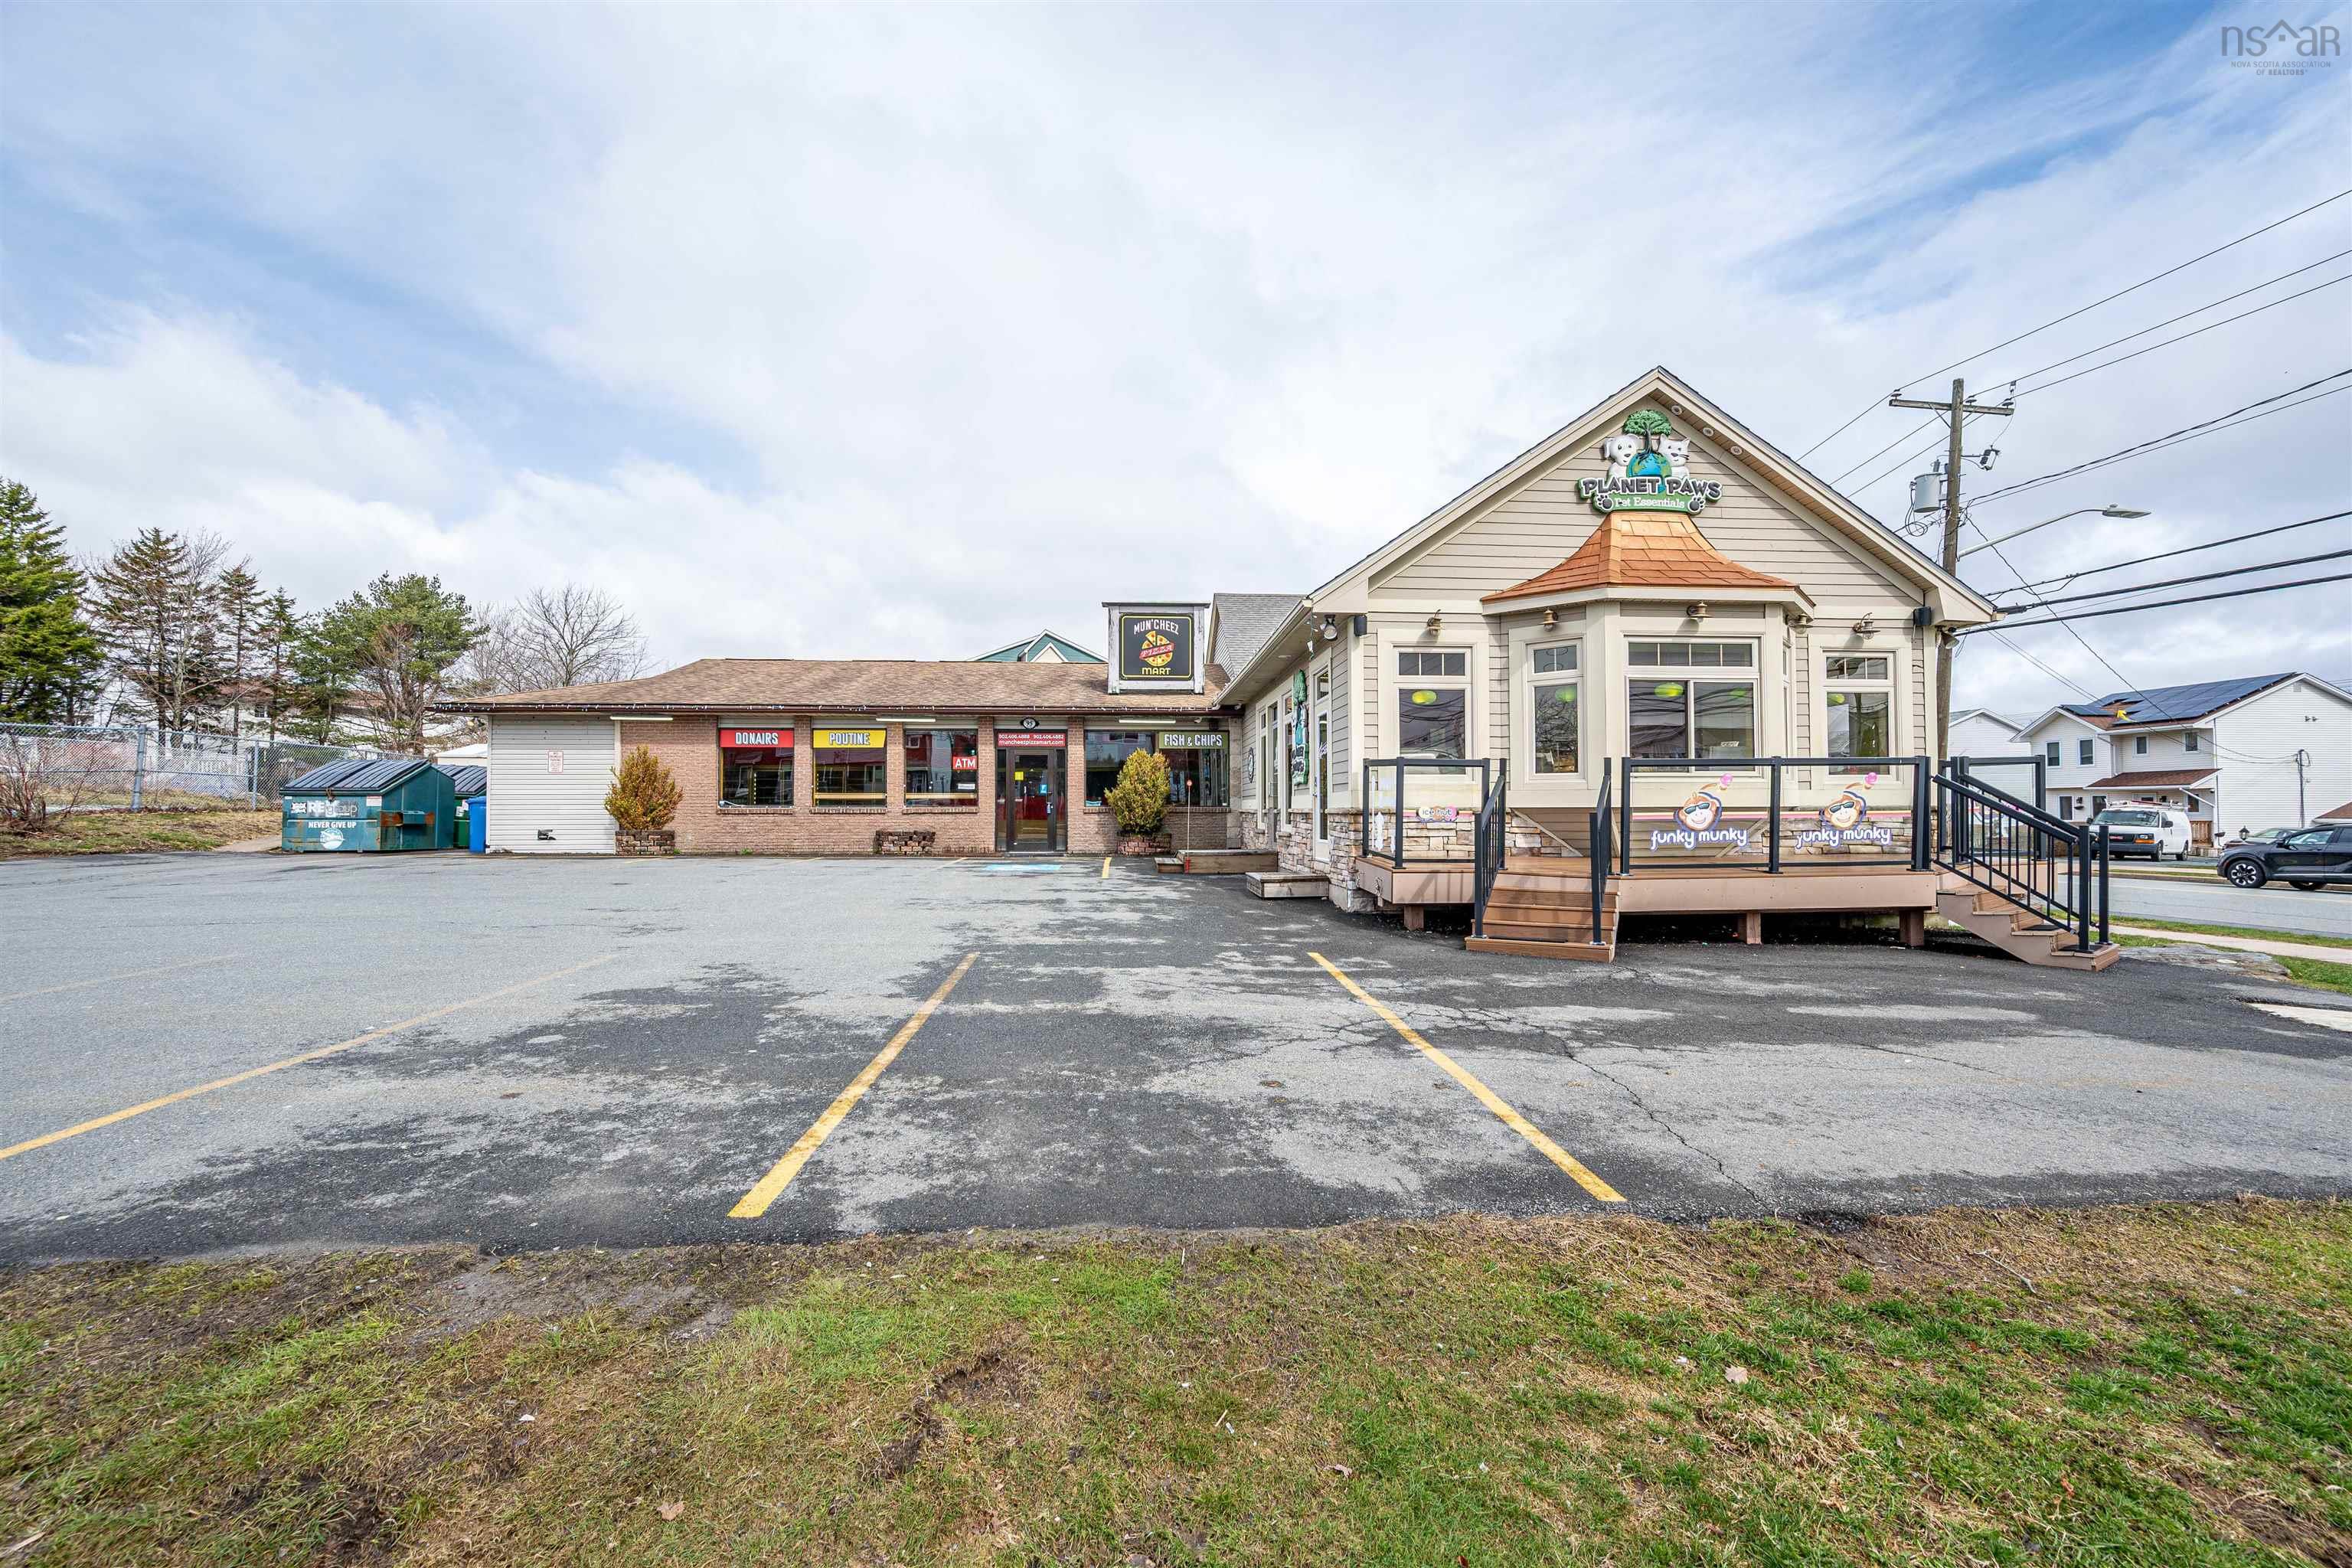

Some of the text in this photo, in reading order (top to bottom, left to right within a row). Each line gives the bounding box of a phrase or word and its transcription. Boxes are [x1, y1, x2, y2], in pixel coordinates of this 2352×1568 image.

[1582, 477, 1722, 498] PLANET PAWS
[1614, 497, 1685, 508] Pet Essentials
[1133, 619, 1179, 635] MUN'CHEEZ
[1142, 667, 1171, 675] MART
[735, 732, 779, 745] DONAIRS
[829, 733, 871, 745] POUTINE
[1164, 734, 1223, 746] FISH & CHIPS
[955, 758, 976, 768] ATM
[1650, 828, 1748, 851] funky munky
[1843, 827, 1891, 844] munky
